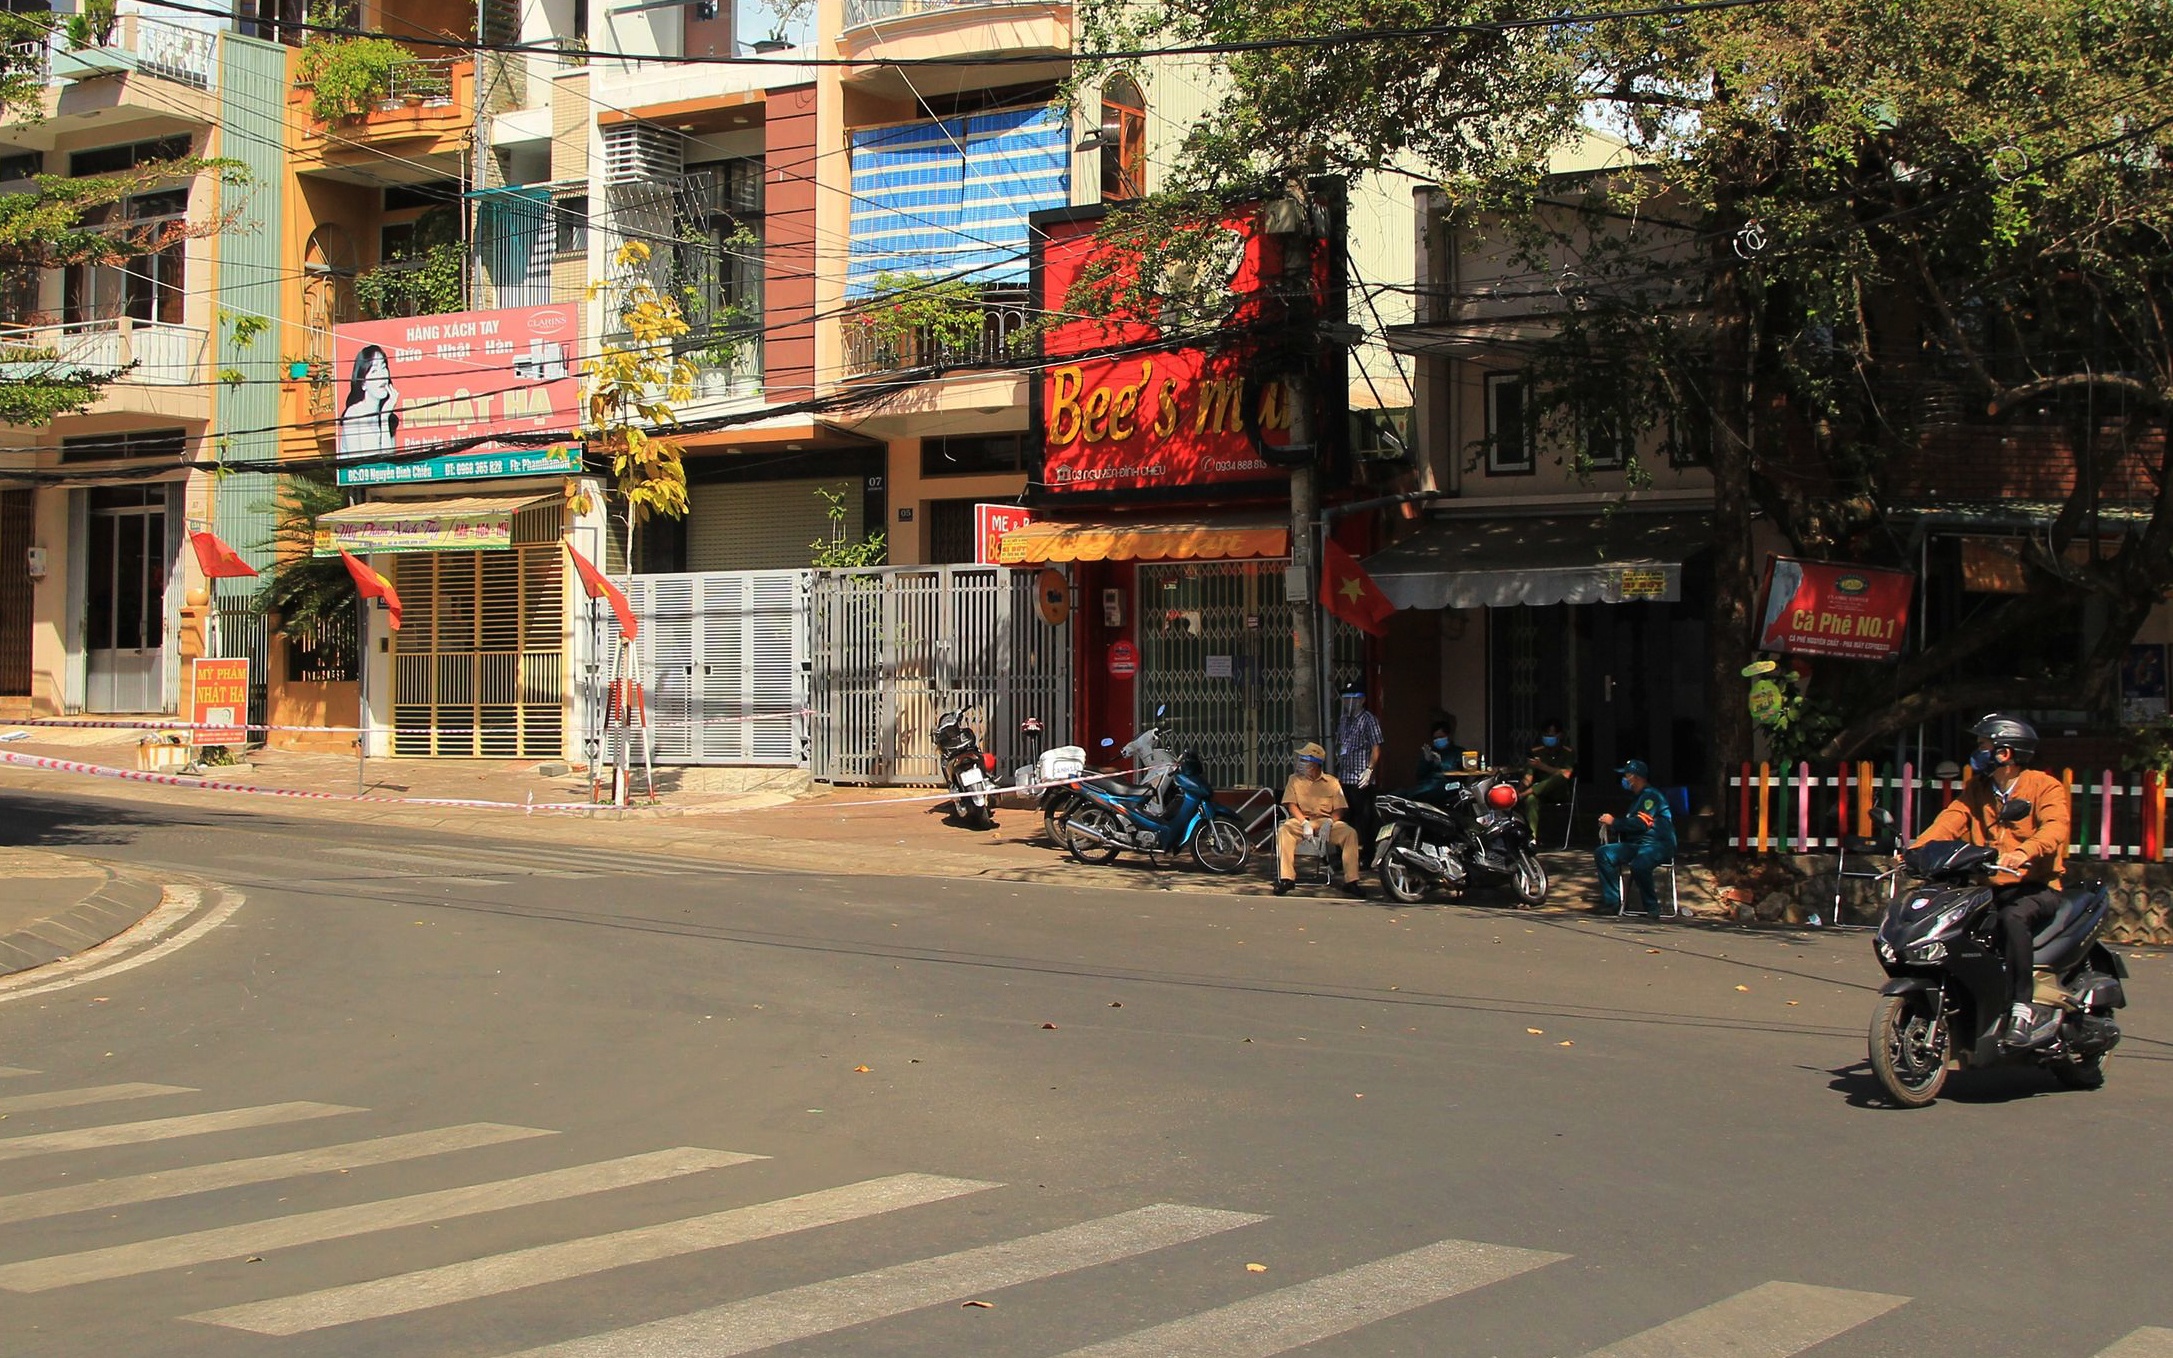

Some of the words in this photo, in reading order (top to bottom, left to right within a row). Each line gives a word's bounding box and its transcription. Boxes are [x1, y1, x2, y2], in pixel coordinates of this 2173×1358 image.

[406, 324, 440, 342] HÀNG
[443, 318, 476, 338] XÁCH
[480, 320, 500, 335] TAY
[437, 342, 471, 363] Nhật
[485, 339, 514, 355] Hàn
[402, 387, 495, 431] NHẬT
[502, 388, 554, 426] HẠ
[1050, 359, 1177, 445] Bee's
[1215, 460, 1236, 472] 0934
[1237, 460, 1253, 470] 888
[868, 476, 882, 487] 07
[992, 515, 1010, 532] ME
[1792, 609, 1815, 632] Cà
[1818, 612, 1852, 635] Phê
[1855, 615, 1895, 639] NO.1
[197, 665, 214, 681] MỸ
[217, 661, 247, 681] PHẨM
[196, 681, 227, 707] NHẬT
[229, 685, 245, 707] HẠ
